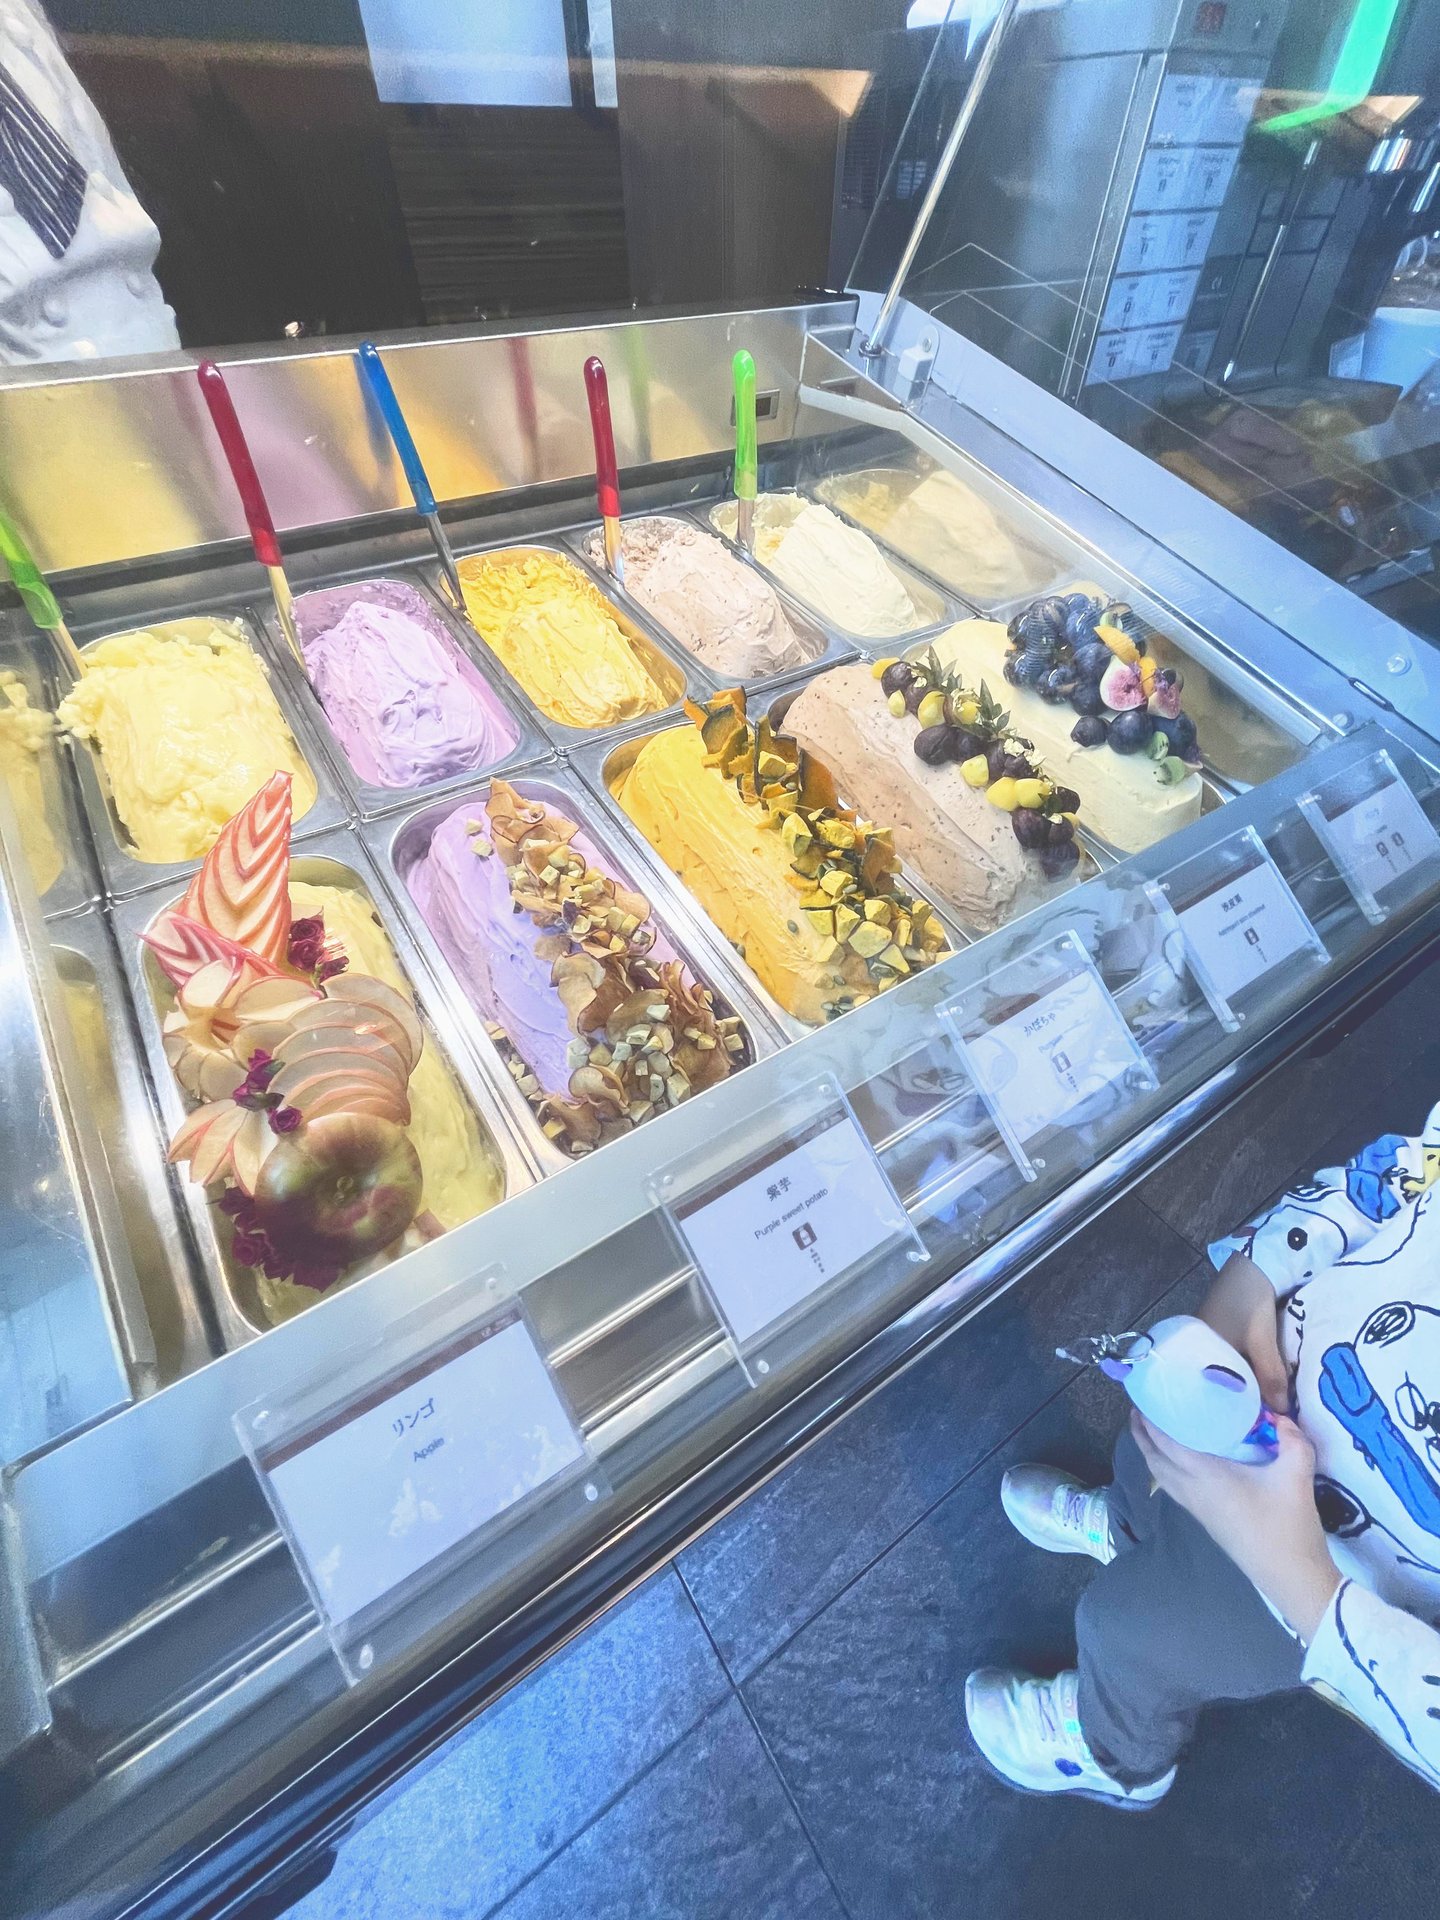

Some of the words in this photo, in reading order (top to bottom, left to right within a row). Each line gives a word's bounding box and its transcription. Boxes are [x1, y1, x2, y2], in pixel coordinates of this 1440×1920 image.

[1023, 1013, 1056, 1037] かぼちゃ
[766, 1176, 792, 1201] 紫芋
[754, 1218, 781, 1239] Purple
[781, 1203, 805, 1223] sweet
[805, 1187, 829, 1209] potato
[392, 1398, 434, 1437] リンゴ
[413, 1437, 444, 1462] Apple
